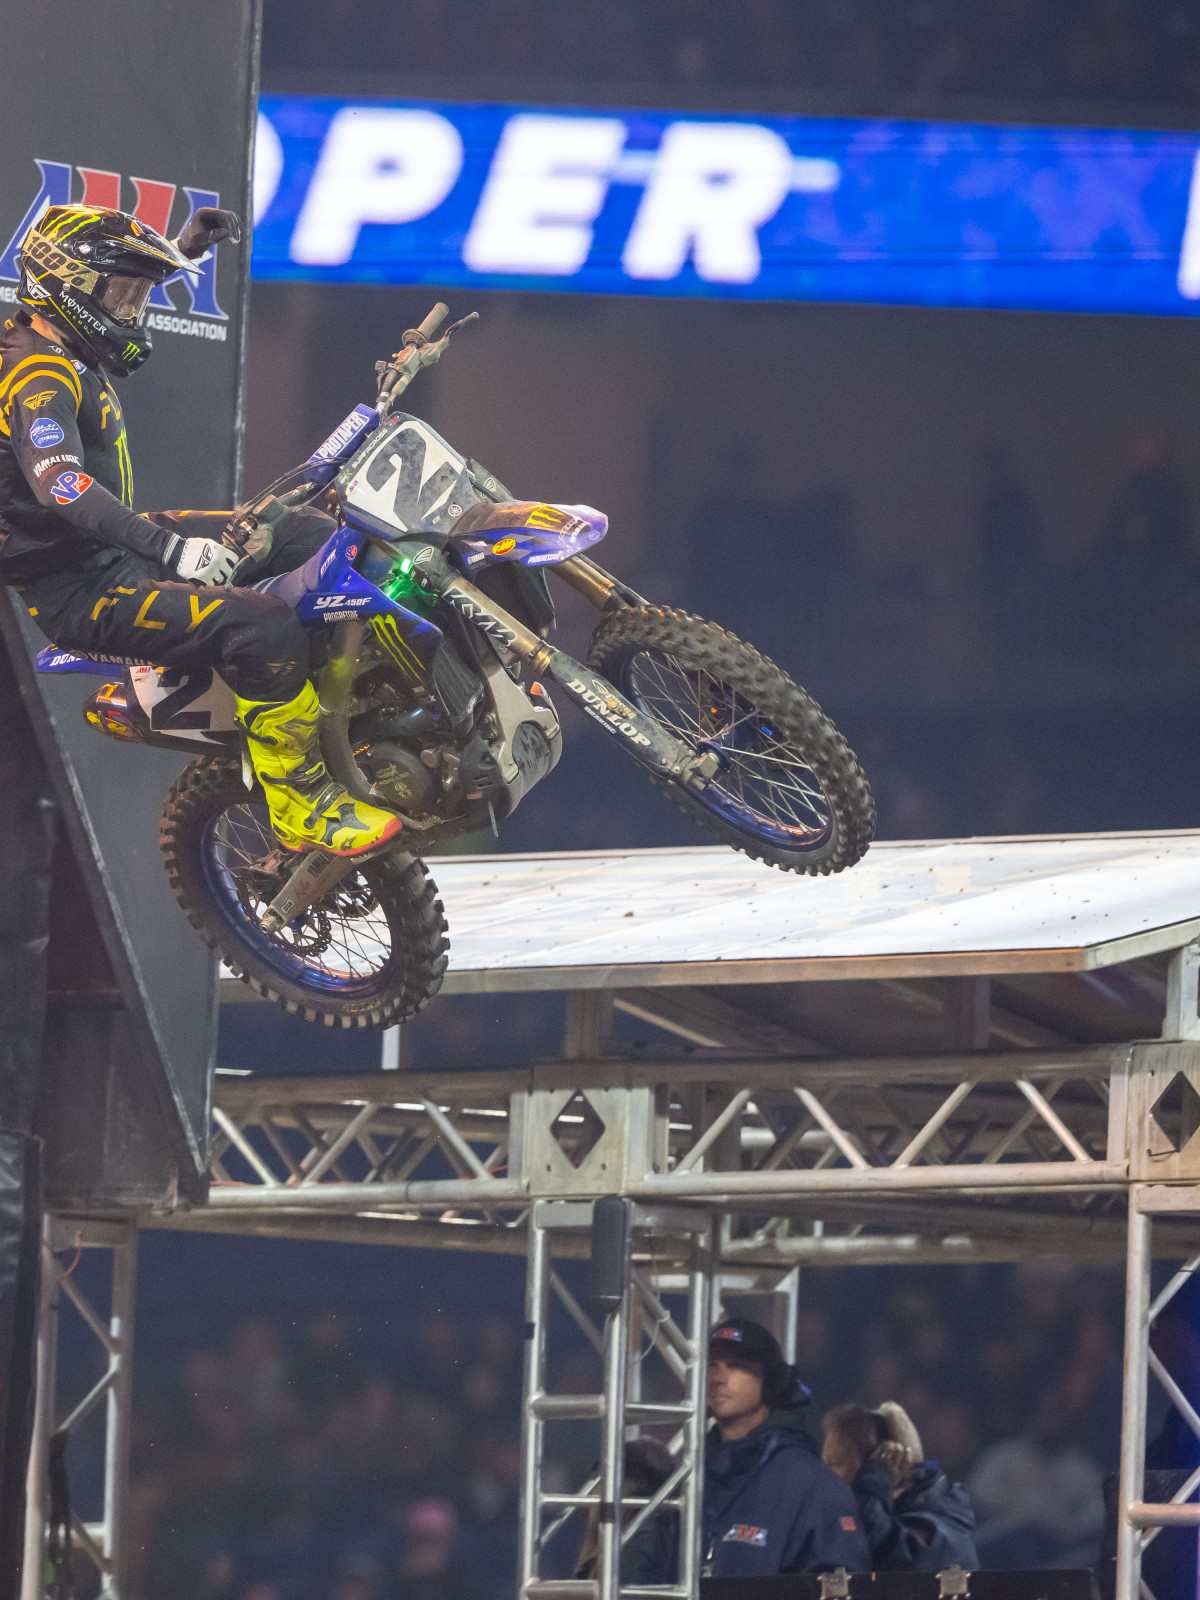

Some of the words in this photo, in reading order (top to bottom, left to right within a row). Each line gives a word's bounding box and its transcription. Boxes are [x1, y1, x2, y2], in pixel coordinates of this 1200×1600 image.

[254, 106, 789, 284] PER
[26, 235, 92, 287] 100%
[58, 290, 107, 336] MONSTER
[146, 312, 228, 342] ASSOCIATION
[316, 412, 367, 462] PROTAPER
[50, 471, 80, 501] VP
[365, 426, 460, 526] 2
[313, 595, 346, 610] YZ
[345, 597, 373, 606] 450F
[151, 665, 213, 731] 2
[566, 678, 651, 746] DUNLOP
